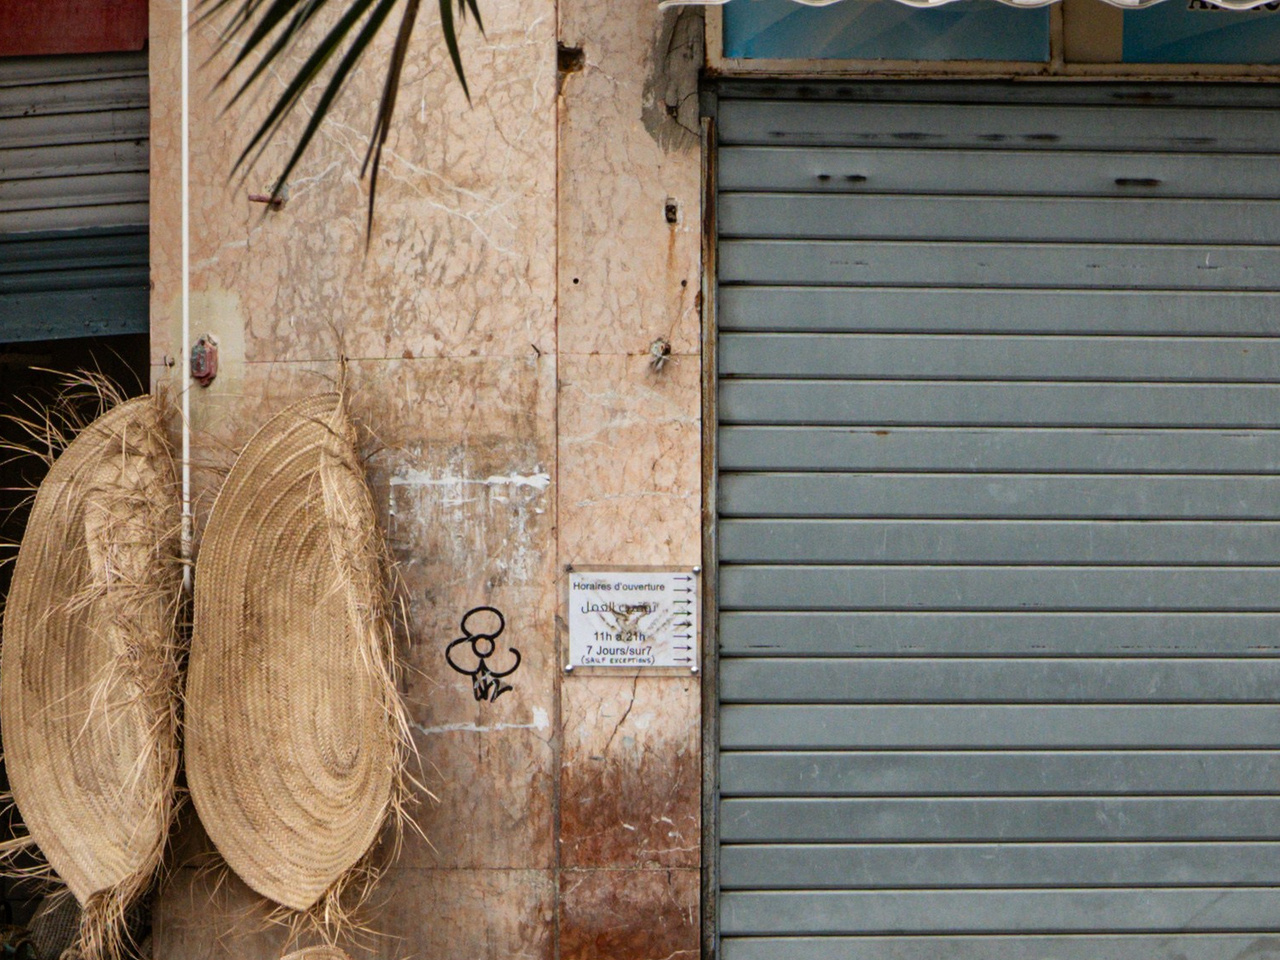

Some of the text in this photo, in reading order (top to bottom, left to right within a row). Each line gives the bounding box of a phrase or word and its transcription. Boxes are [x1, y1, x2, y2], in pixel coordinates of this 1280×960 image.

[573, 582, 665, 591] Horaires d'ouverture
[593, 631, 612, 641] 11h
[625, 631, 646, 641] 21h
[586, 646, 652, 655] 7 Jours/sur7
